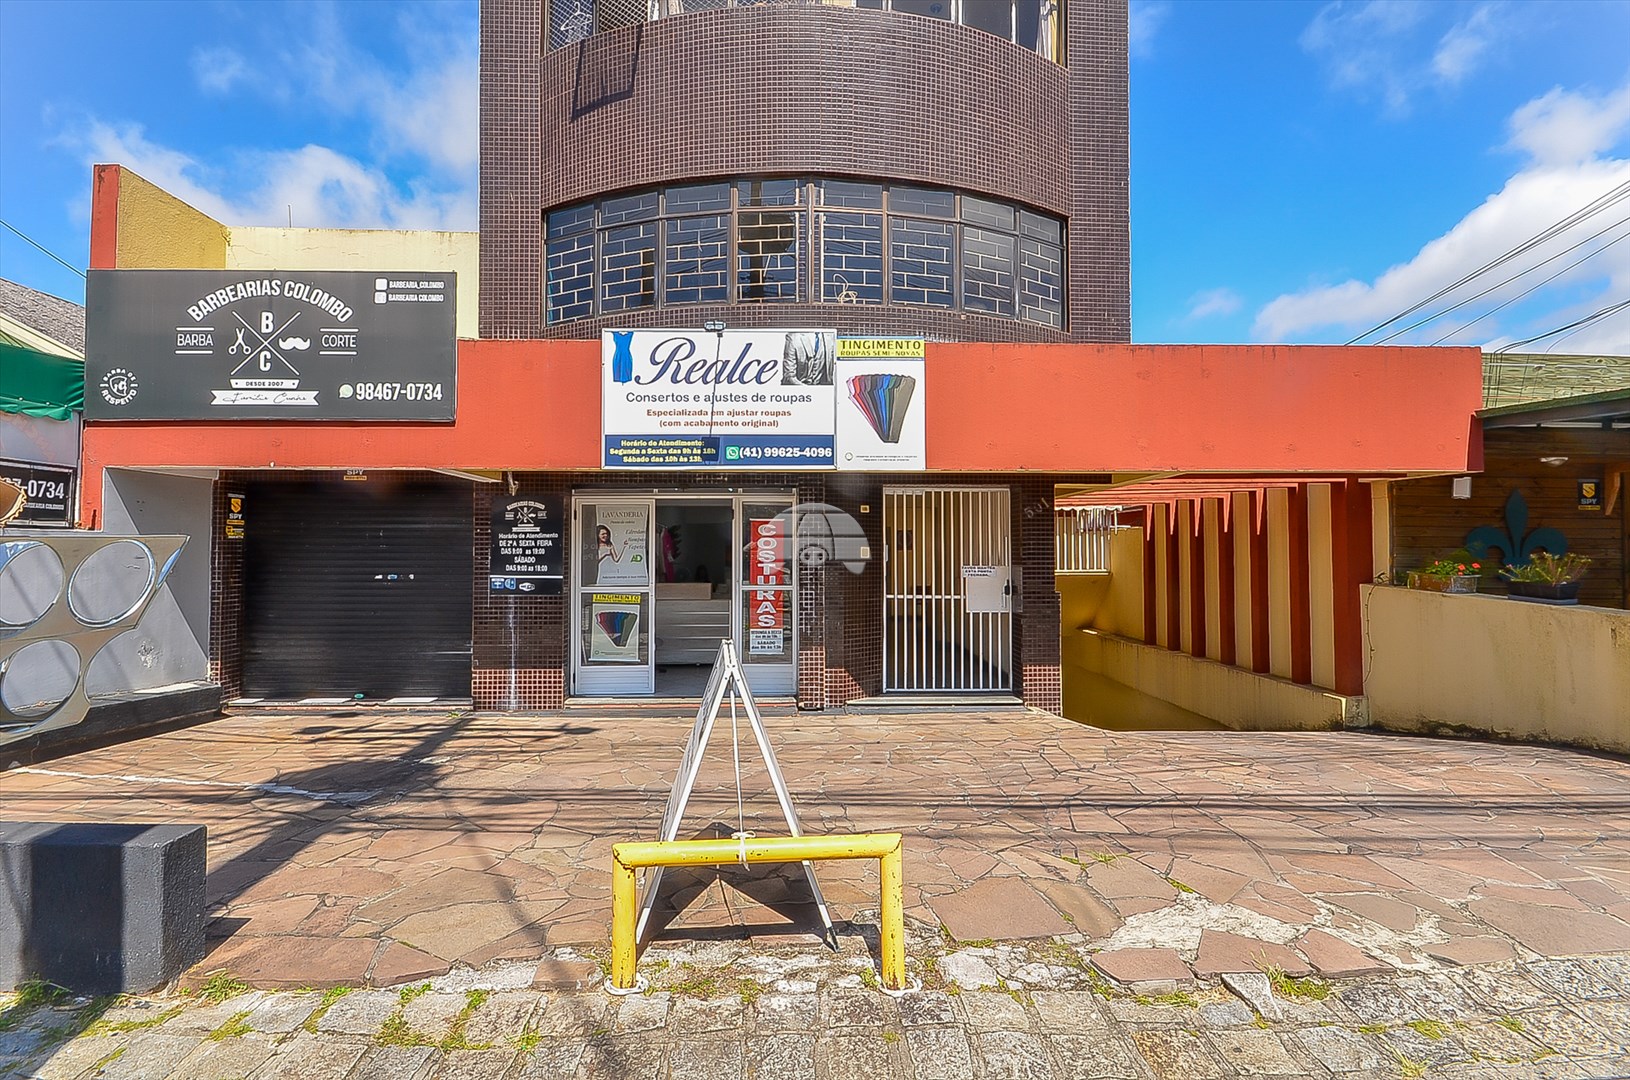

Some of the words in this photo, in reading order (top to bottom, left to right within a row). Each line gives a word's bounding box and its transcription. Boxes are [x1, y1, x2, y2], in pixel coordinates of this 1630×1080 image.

[187, 278, 281, 322] BARBEARIAS
[283, 280, 354, 323] COLOMBO
[260, 311, 274, 334] B
[177, 333, 214, 346] BARBA
[321, 334, 356, 347] CORTE
[840, 340, 921, 350] TINGIMENTO
[259, 351, 272, 371] C
[634, 336, 778, 386] Realce
[356, 383, 443, 401] 98467-0734
[626, 392, 690, 404] Consertos
[692, 392, 701, 404] e
[703, 392, 748, 404] ajustes
[751, 392, 767, 404] de
[769, 392, 812, 404] roupas
[646, 409, 708, 419] Especializada
[711, 409, 725, 419] em
[726, 409, 758, 419] ajustar
[760, 409, 792, 419] roupas
[659, 419, 681, 429] (com
[683, 419, 739, 429] acabamento
[740, 419, 779, 429] original)
[621, 439, 647, 447] Horário
[648, 439, 657, 447] de
[658, 439, 704, 447] Atendimento:
[609, 448, 640, 456] Segunda
[647, 448, 667, 456] Sexta
[668, 448, 681, 456] das
[740, 447, 761, 458] (41)
[764, 447, 832, 458] 99625-4096
[514, 555, 536, 564] SÁBADO
[756, 524, 777, 627] COSTURAS
